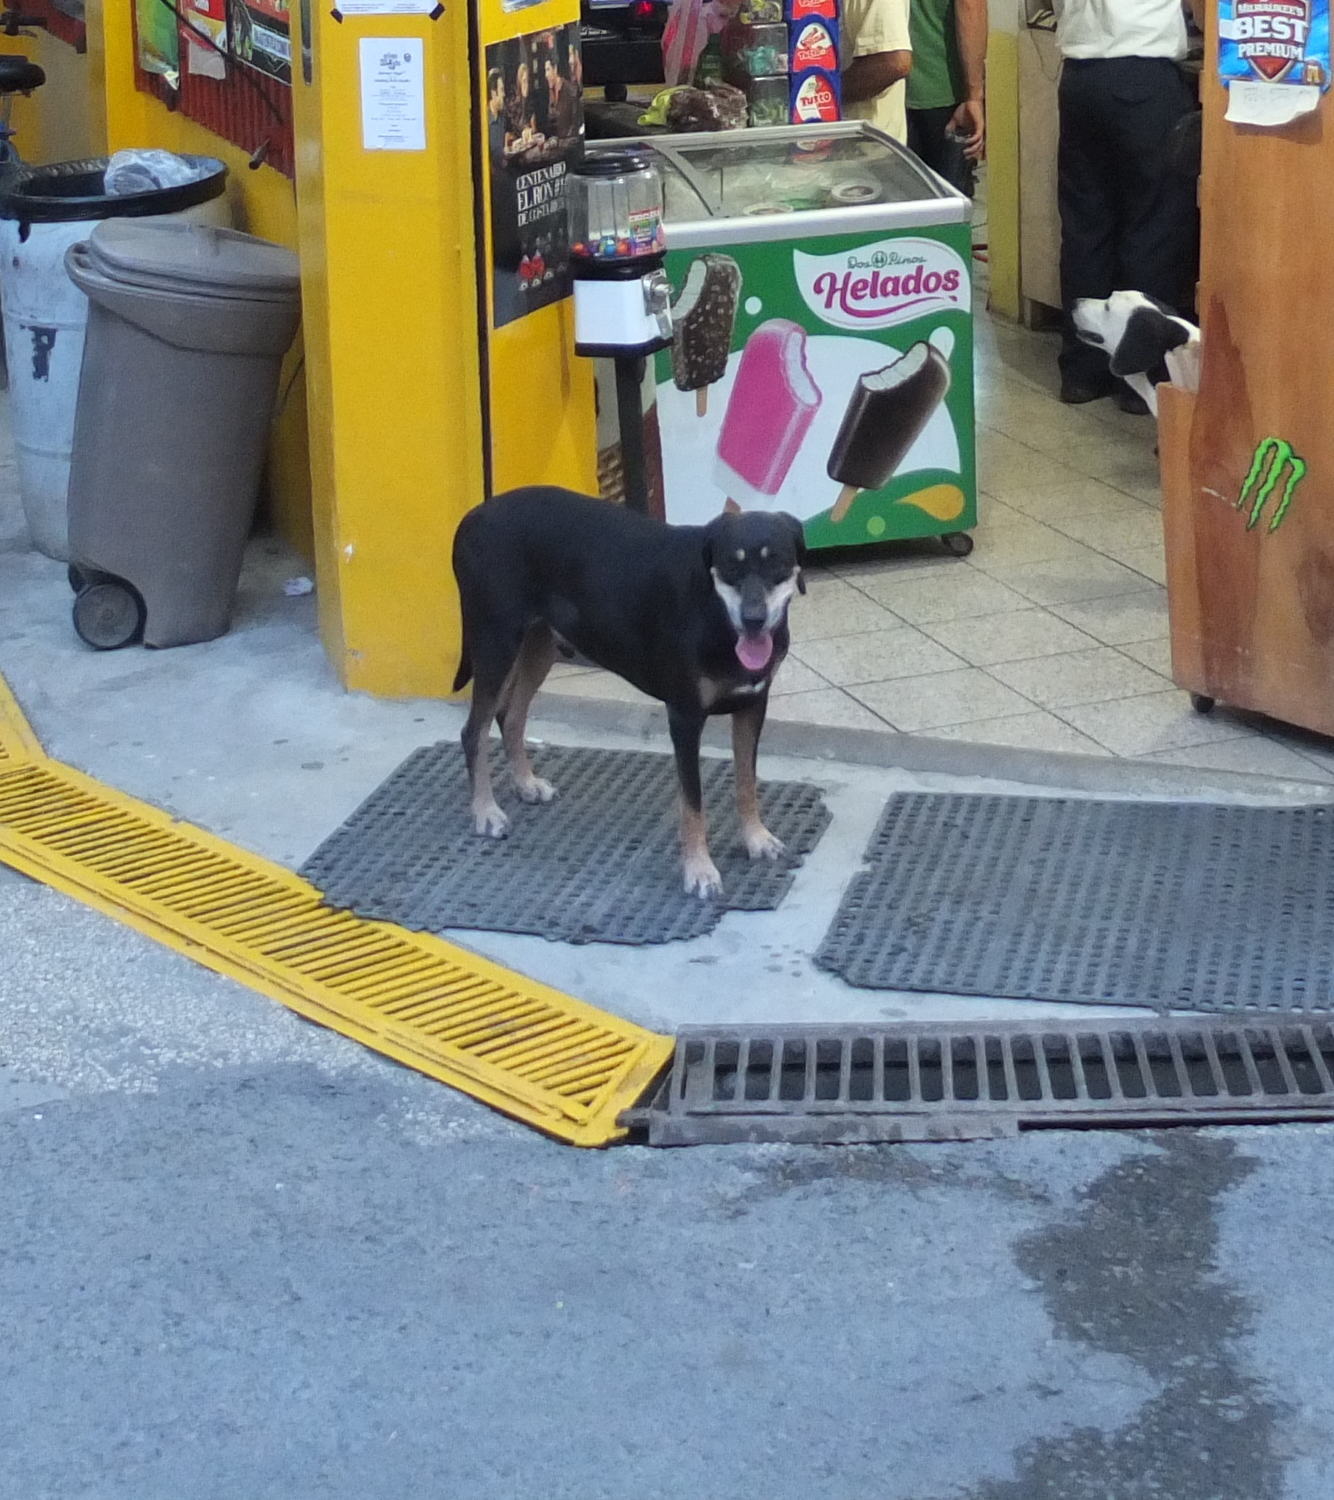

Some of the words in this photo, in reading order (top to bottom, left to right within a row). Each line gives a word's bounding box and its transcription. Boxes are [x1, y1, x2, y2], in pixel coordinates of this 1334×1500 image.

[1233, 15, 1309, 44] BEST
[1237, 42, 1305, 62] PREMIUM
[516, 161, 566, 191] CENTENARIO
[517, 190, 533, 212] EL
[532, 182, 554, 206] RON
[847, 256, 872, 269] Dos
[888, 252, 927, 266] Pinos
[813, 265, 959, 315] Helados
